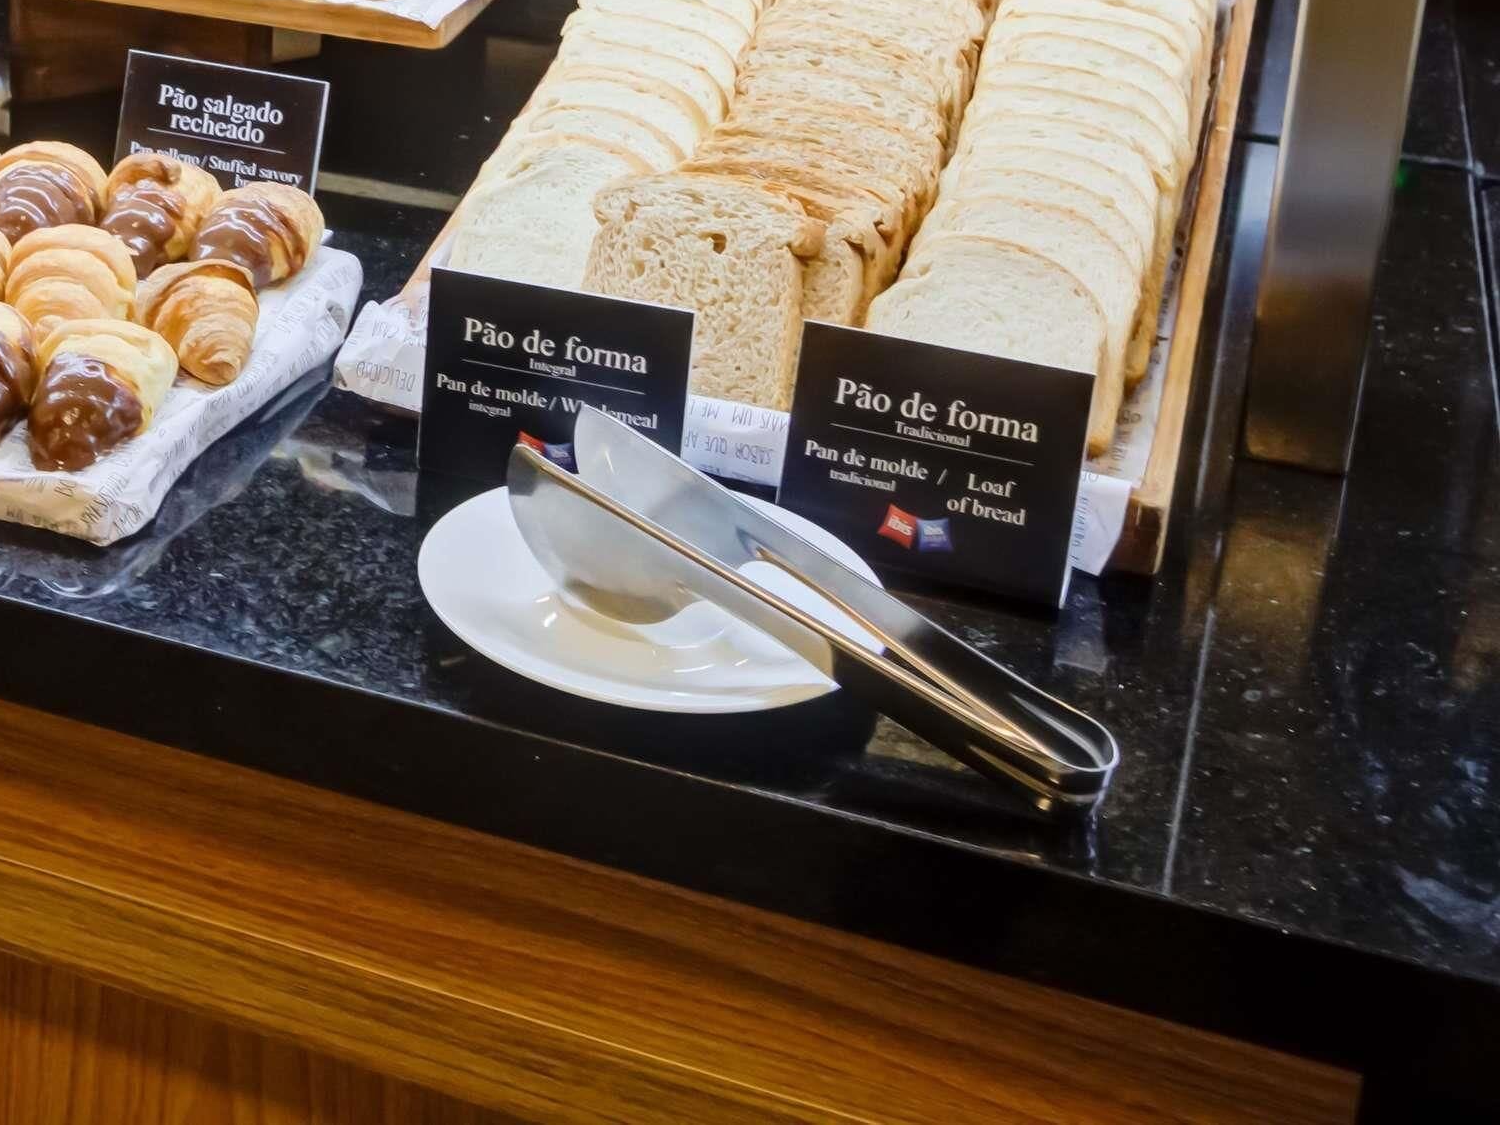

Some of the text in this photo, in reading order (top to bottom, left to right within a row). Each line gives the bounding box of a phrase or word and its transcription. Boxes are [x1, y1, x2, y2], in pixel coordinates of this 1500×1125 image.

[158, 84, 284, 125] Pão salgado
[169, 113, 266, 144] recheado
[209, 155, 258, 176] Stuffed
[258, 167, 303, 188] savory
[463, 317, 647, 374] Pão de forma
[529, 358, 576, 377] Integral
[437, 373, 467, 393] Pan
[471, 381, 491, 397] de
[496, 388, 547, 408] molde
[468, 400, 511, 418] integral
[834, 377, 1039, 443] Pão de forma
[895, 421, 970, 447] Tradicional
[804, 439, 838, 462] Pan
[843, 448, 865, 467] de
[870, 456, 928, 481] molde
[968, 473, 1016, 498] Loaf
[829, 469, 896, 492] tradicional
[946, 497, 1027, 526] of bread
